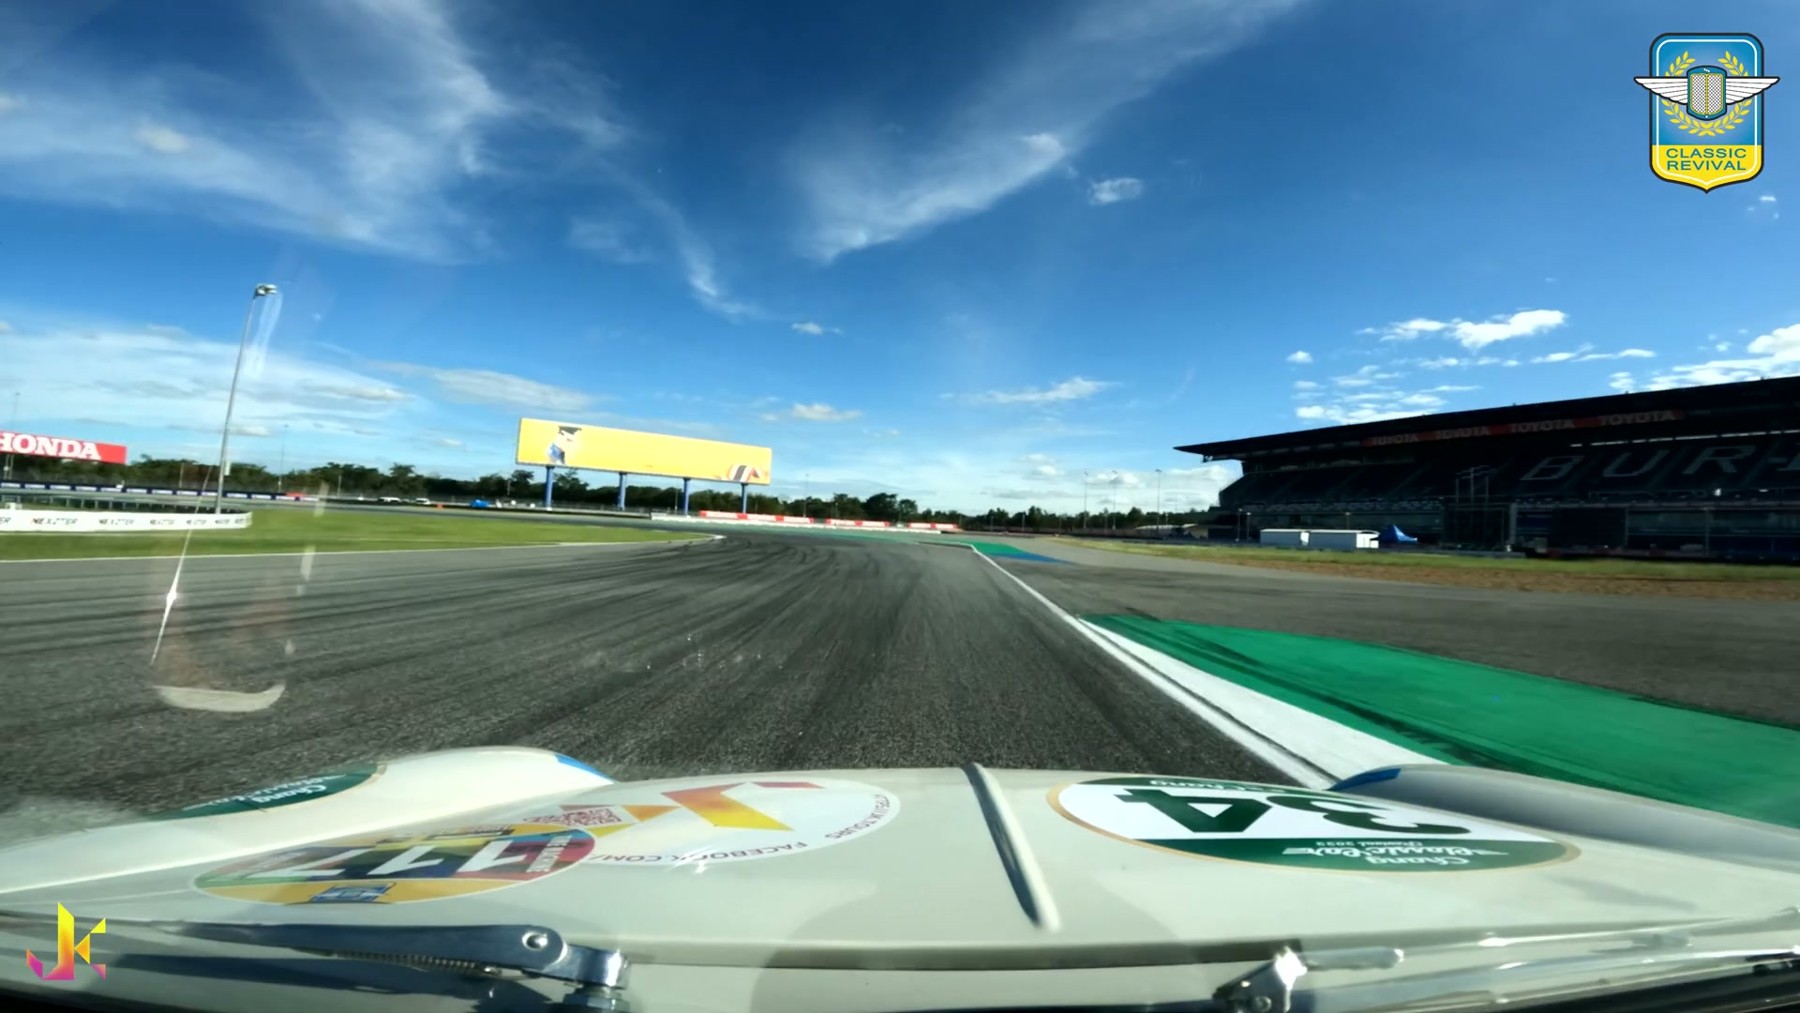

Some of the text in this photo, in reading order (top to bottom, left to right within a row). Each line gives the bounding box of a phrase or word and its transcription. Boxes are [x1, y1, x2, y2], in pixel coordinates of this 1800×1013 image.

[1510, 418, 1575, 432] TOYOTA
[1599, 409, 1678, 425] TOYOTA
[0, 431, 103, 461] HONDA
[1113, 788, 1471, 835] 34
[246, 839, 528, 879] 117
[1364, 856, 1470, 866] Chang
[1365, 846, 1473, 857] Classic
